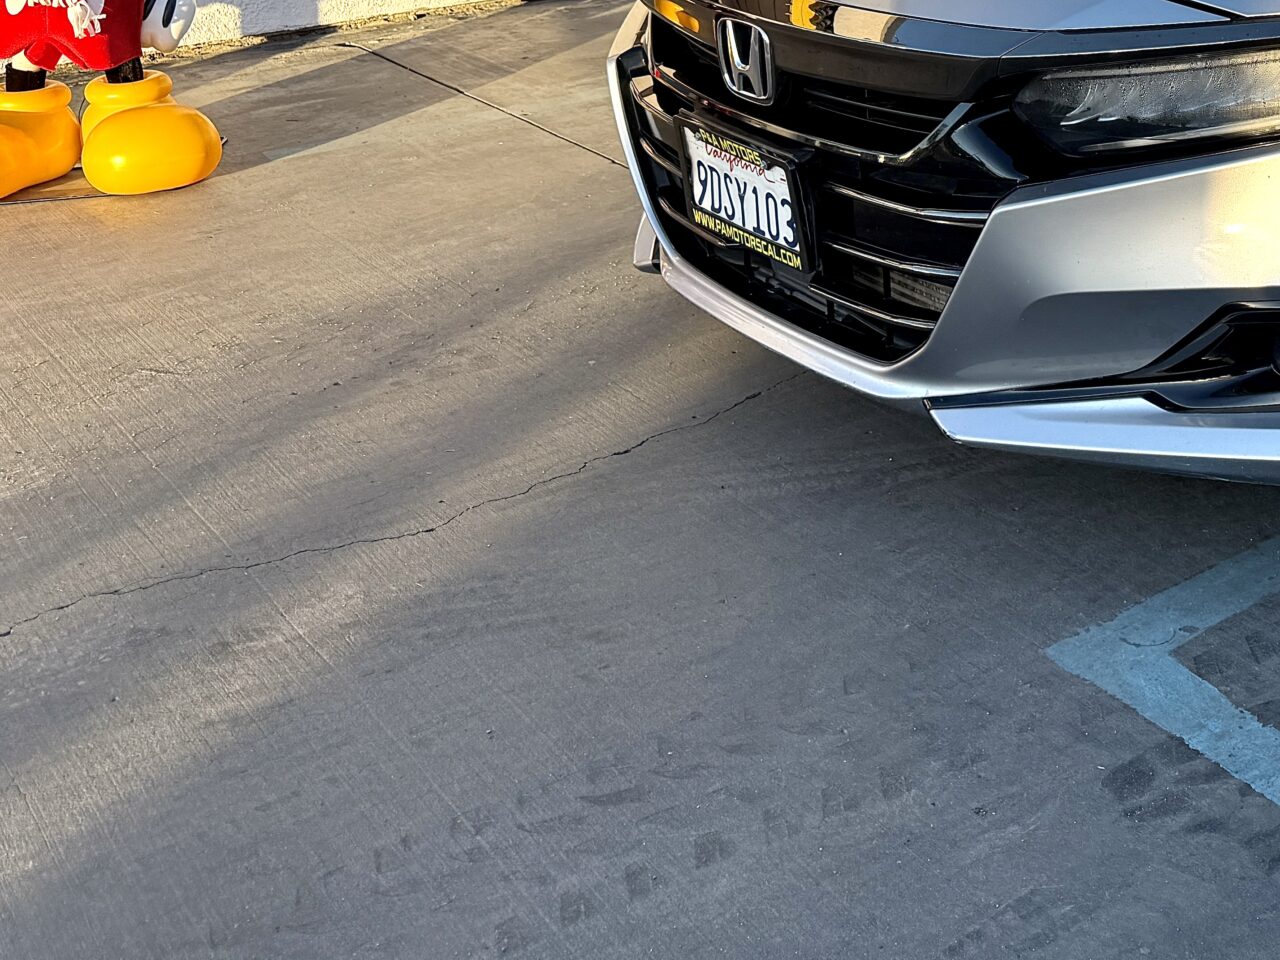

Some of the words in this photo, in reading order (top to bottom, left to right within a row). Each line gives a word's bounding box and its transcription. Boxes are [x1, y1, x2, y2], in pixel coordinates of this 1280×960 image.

[699, 128, 721, 148] P&A
[720, 137, 762, 166] MOTORS
[697, 160, 800, 248] 9DSY103
[692, 208, 802, 270] WWW.PAMOTORSCAL.COM
